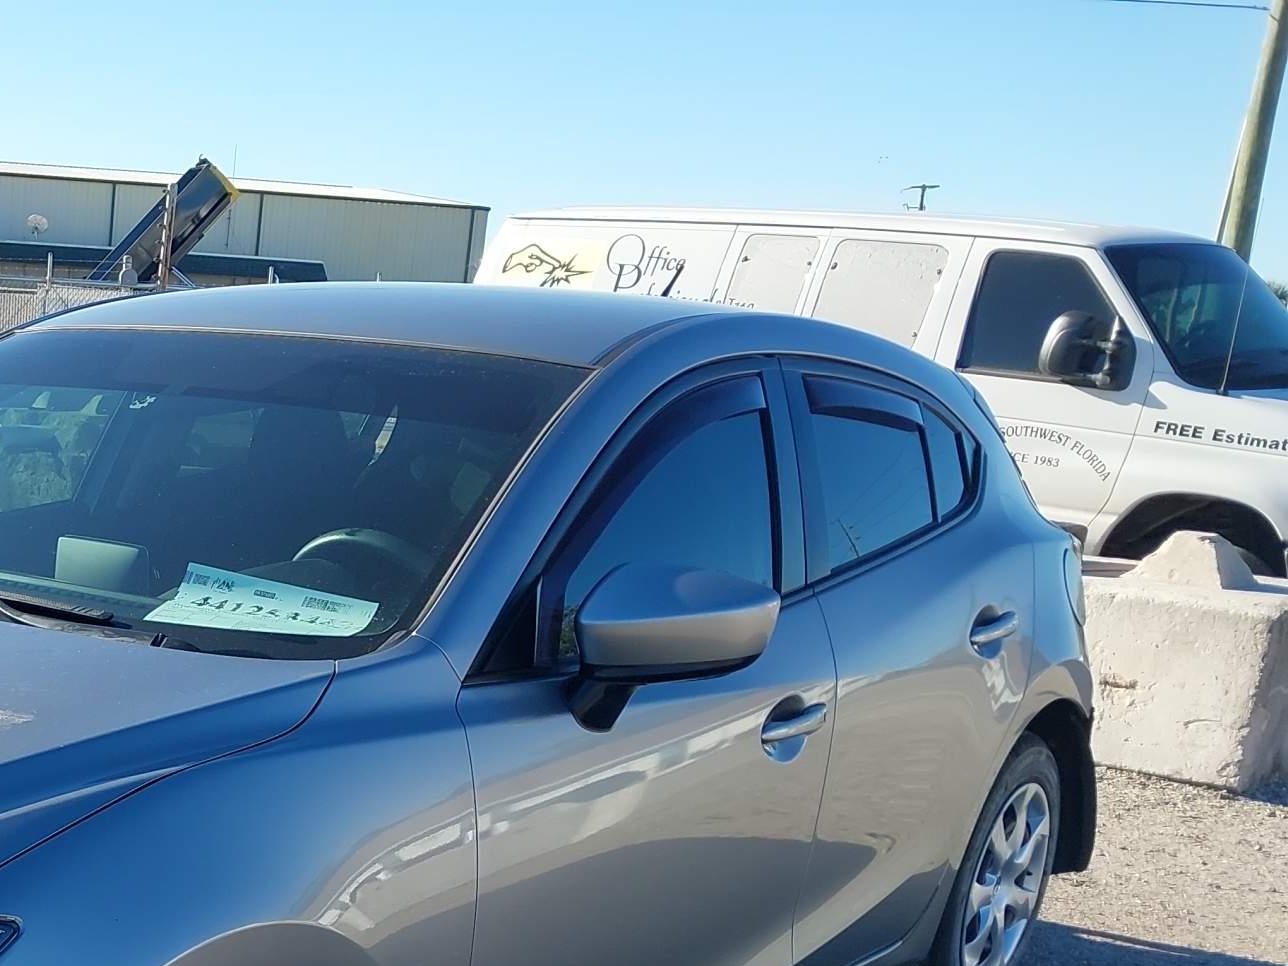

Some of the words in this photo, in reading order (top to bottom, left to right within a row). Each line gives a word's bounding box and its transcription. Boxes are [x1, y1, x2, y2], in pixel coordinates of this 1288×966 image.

[606, 233, 686, 277] Office
[1153, 420, 1206, 439] FREE
[1033, 455, 1060, 468] 1983
[1070, 440, 1112, 482] FLORIDA
